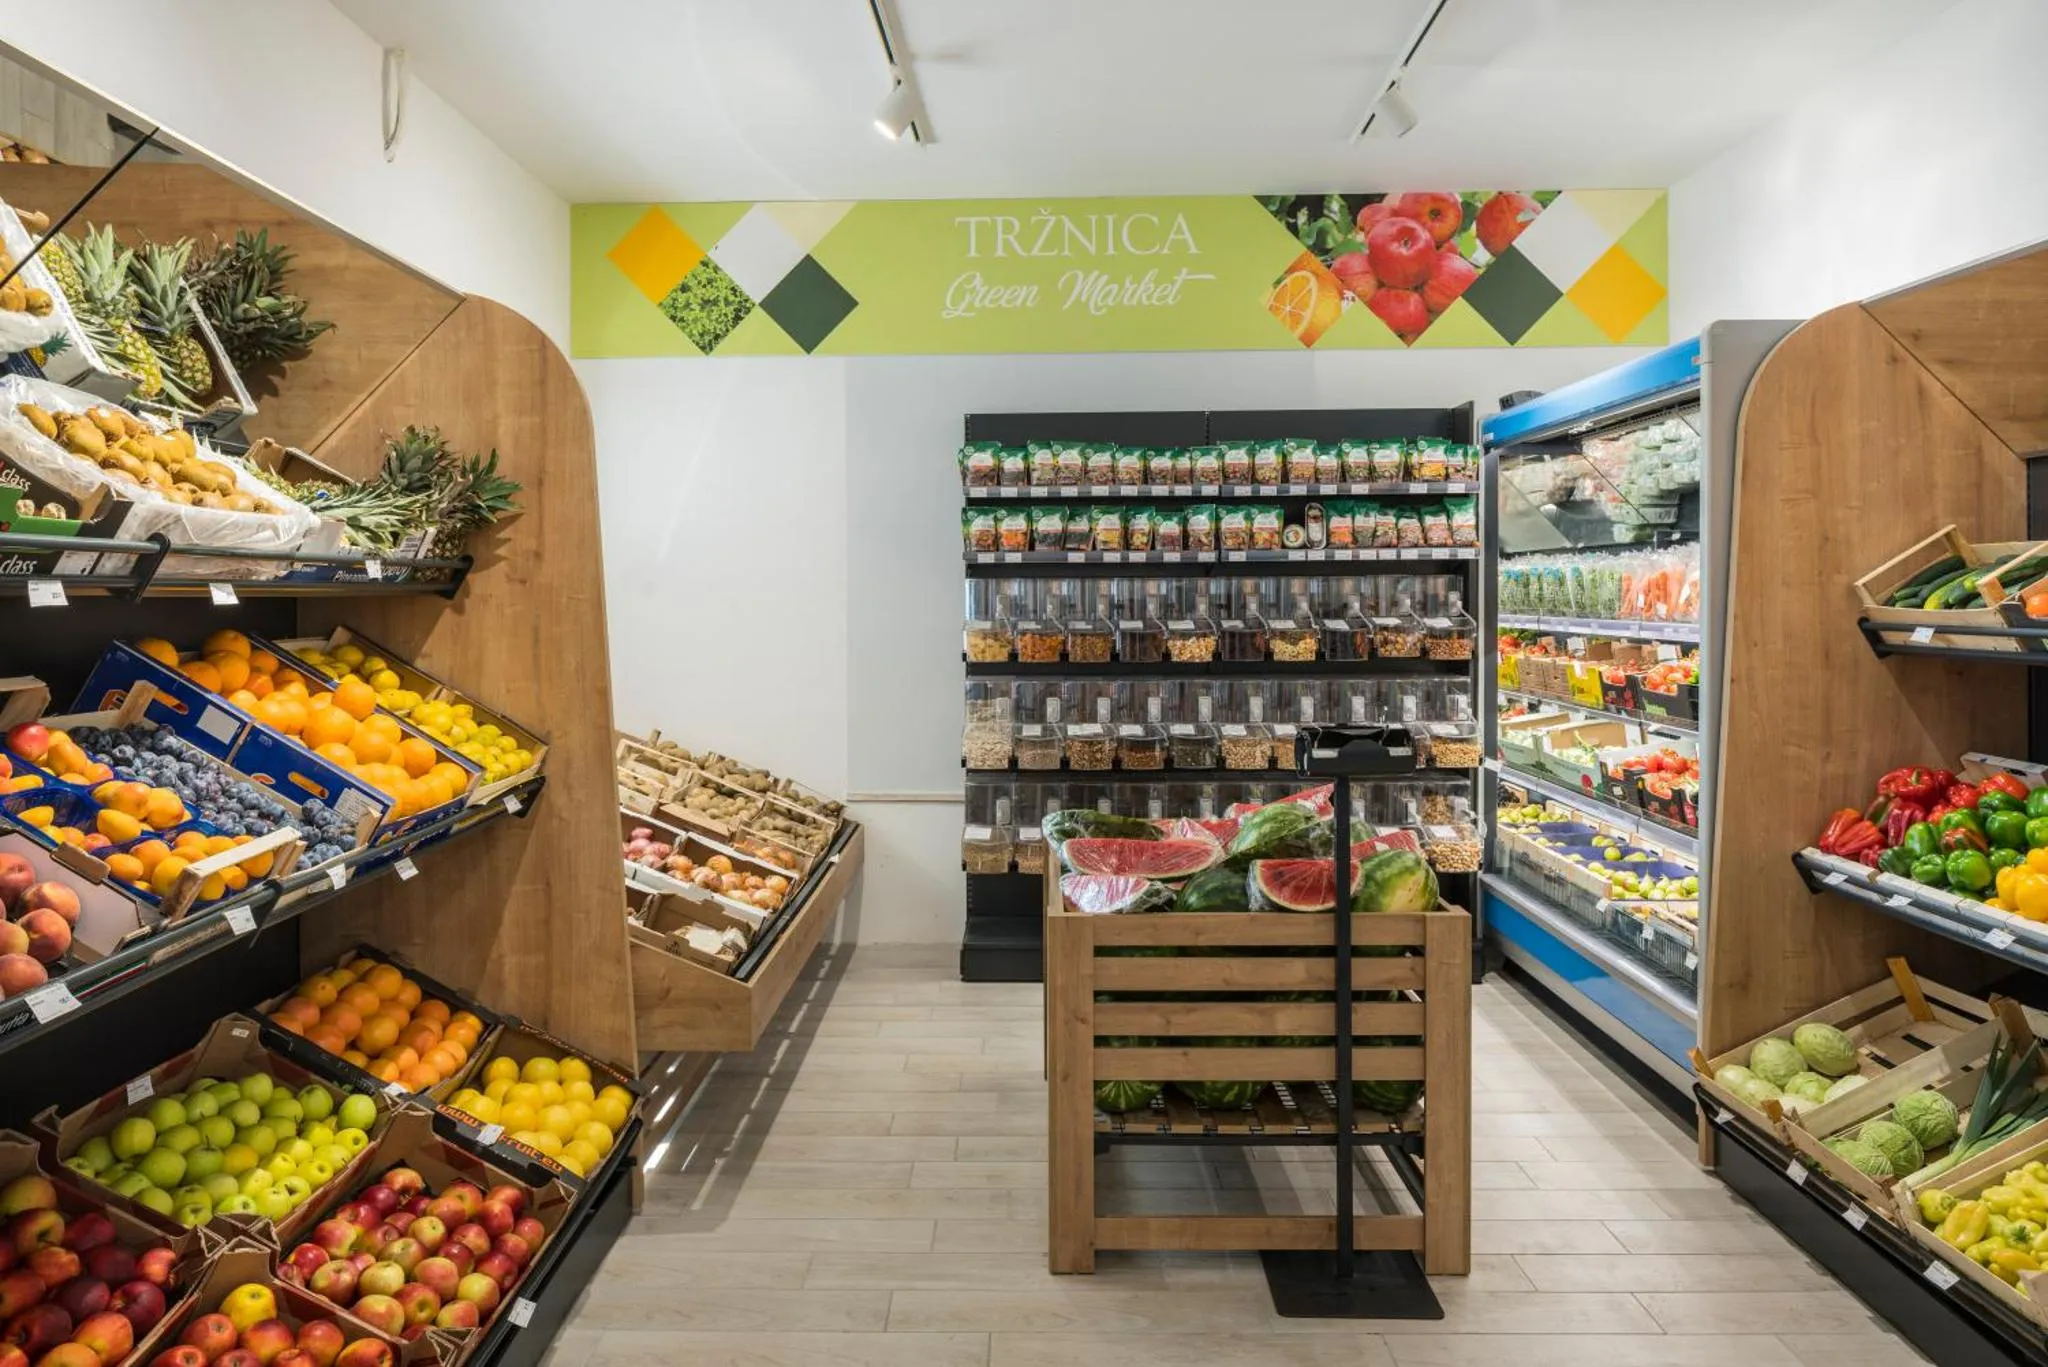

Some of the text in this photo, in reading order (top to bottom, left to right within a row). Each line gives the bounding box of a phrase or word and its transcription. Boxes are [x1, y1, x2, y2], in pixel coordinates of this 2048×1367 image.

[955, 207, 1202, 258] TRŽNICA
[942, 267, 1217, 318] Green Market
